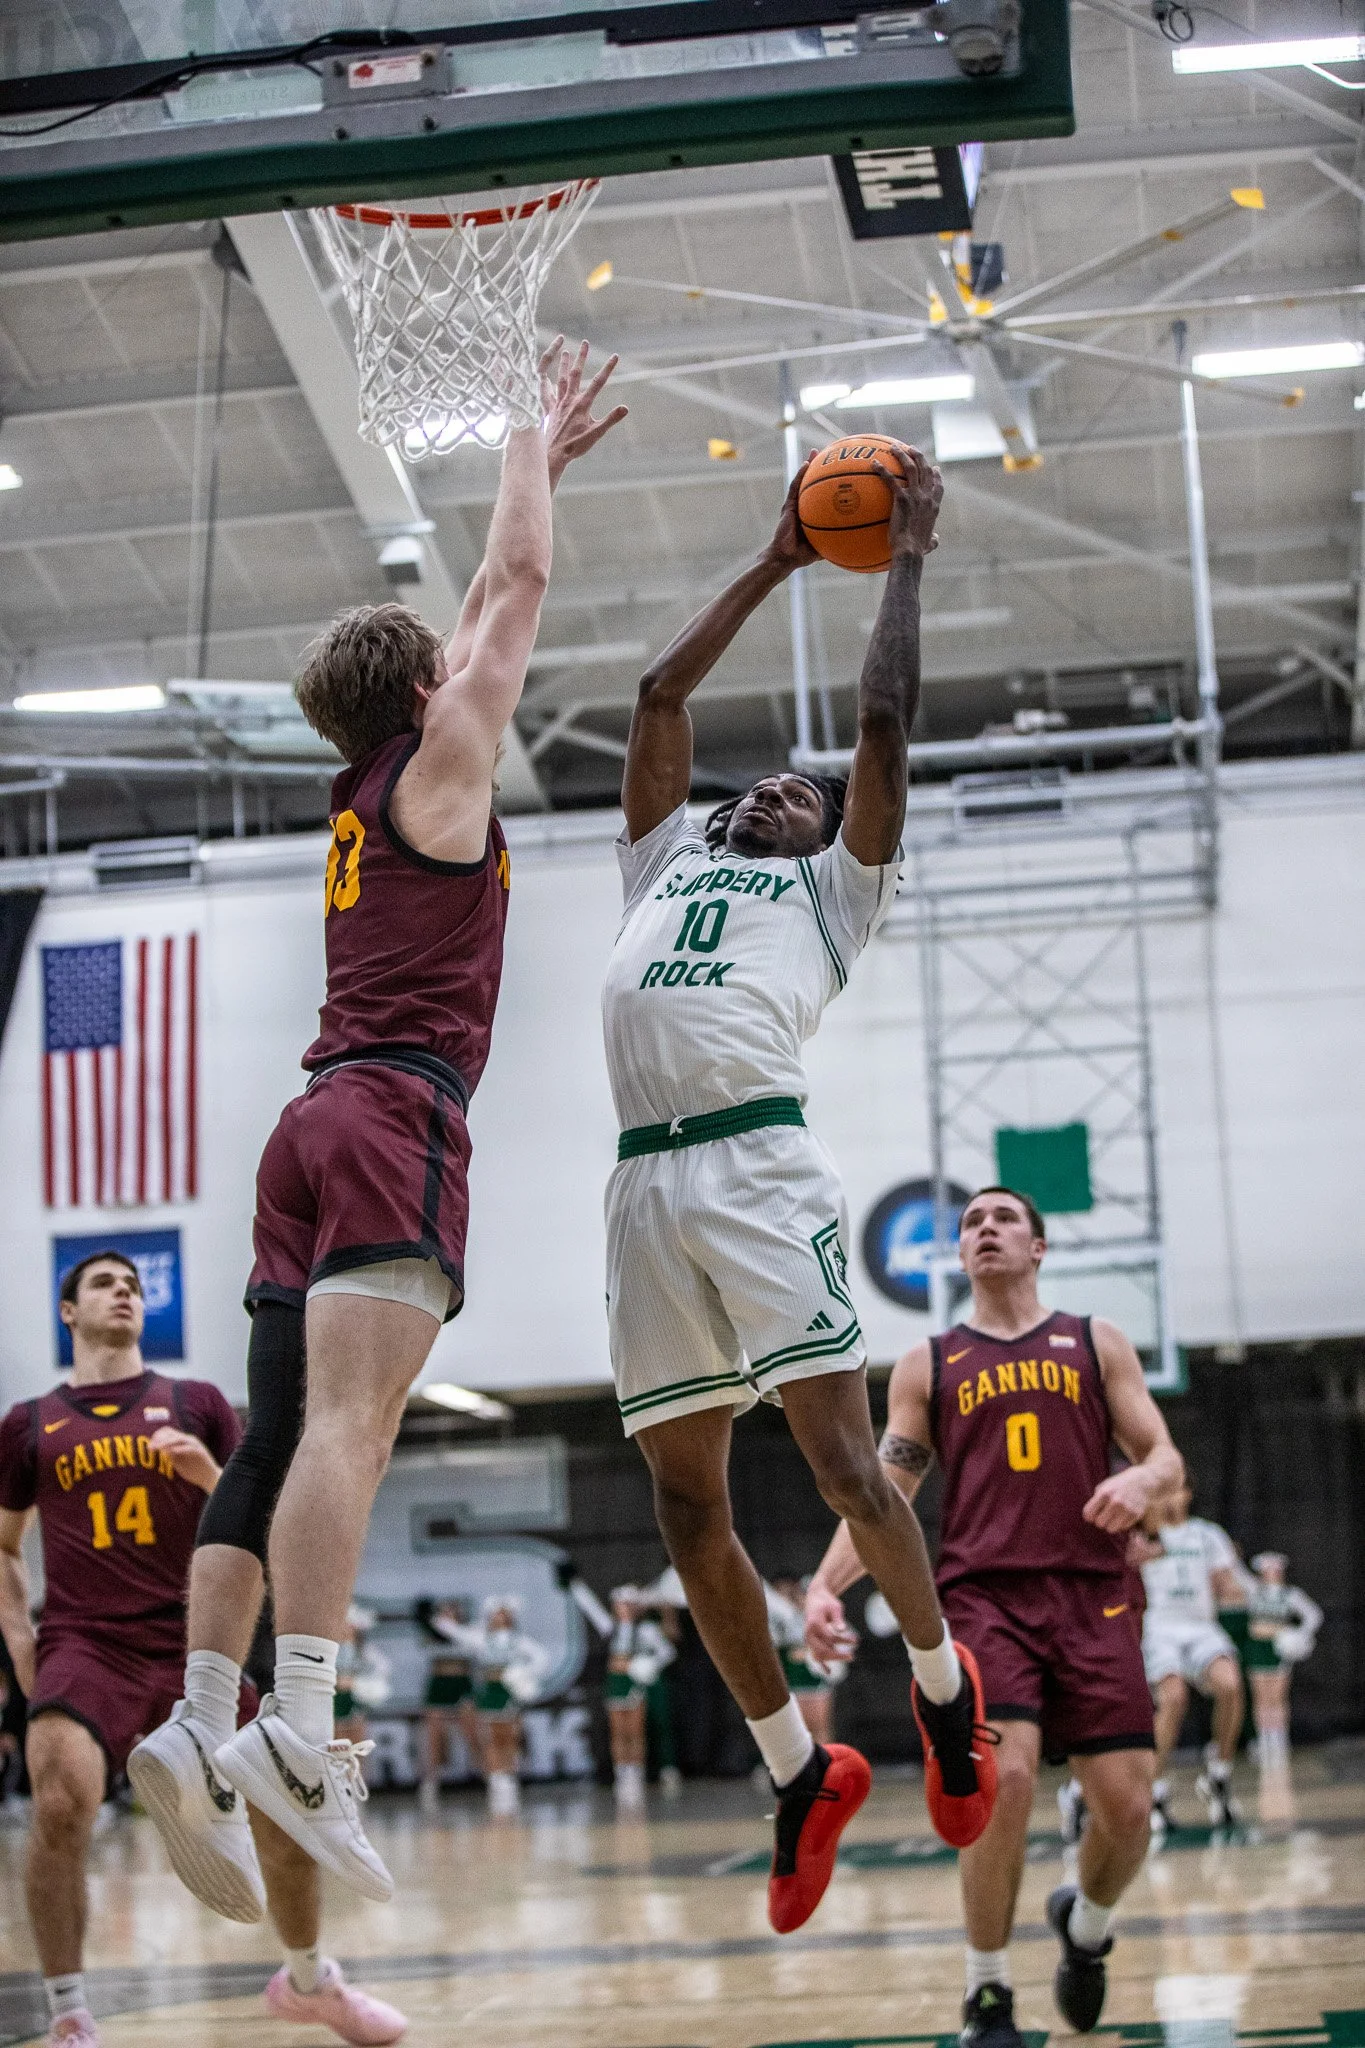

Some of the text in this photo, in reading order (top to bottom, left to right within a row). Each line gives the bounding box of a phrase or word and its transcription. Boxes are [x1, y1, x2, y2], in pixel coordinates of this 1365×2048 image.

[852, 146, 943, 210] TH
[821, 446, 878, 467] EVO
[655, 867, 796, 902] SIPPERY
[673, 898, 730, 954] 10
[639, 960, 736, 990] ROCK
[957, 1360, 1081, 1416] GANNON
[1006, 1411, 1041, 1472] 0
[86, 1485, 157, 1551] 14
